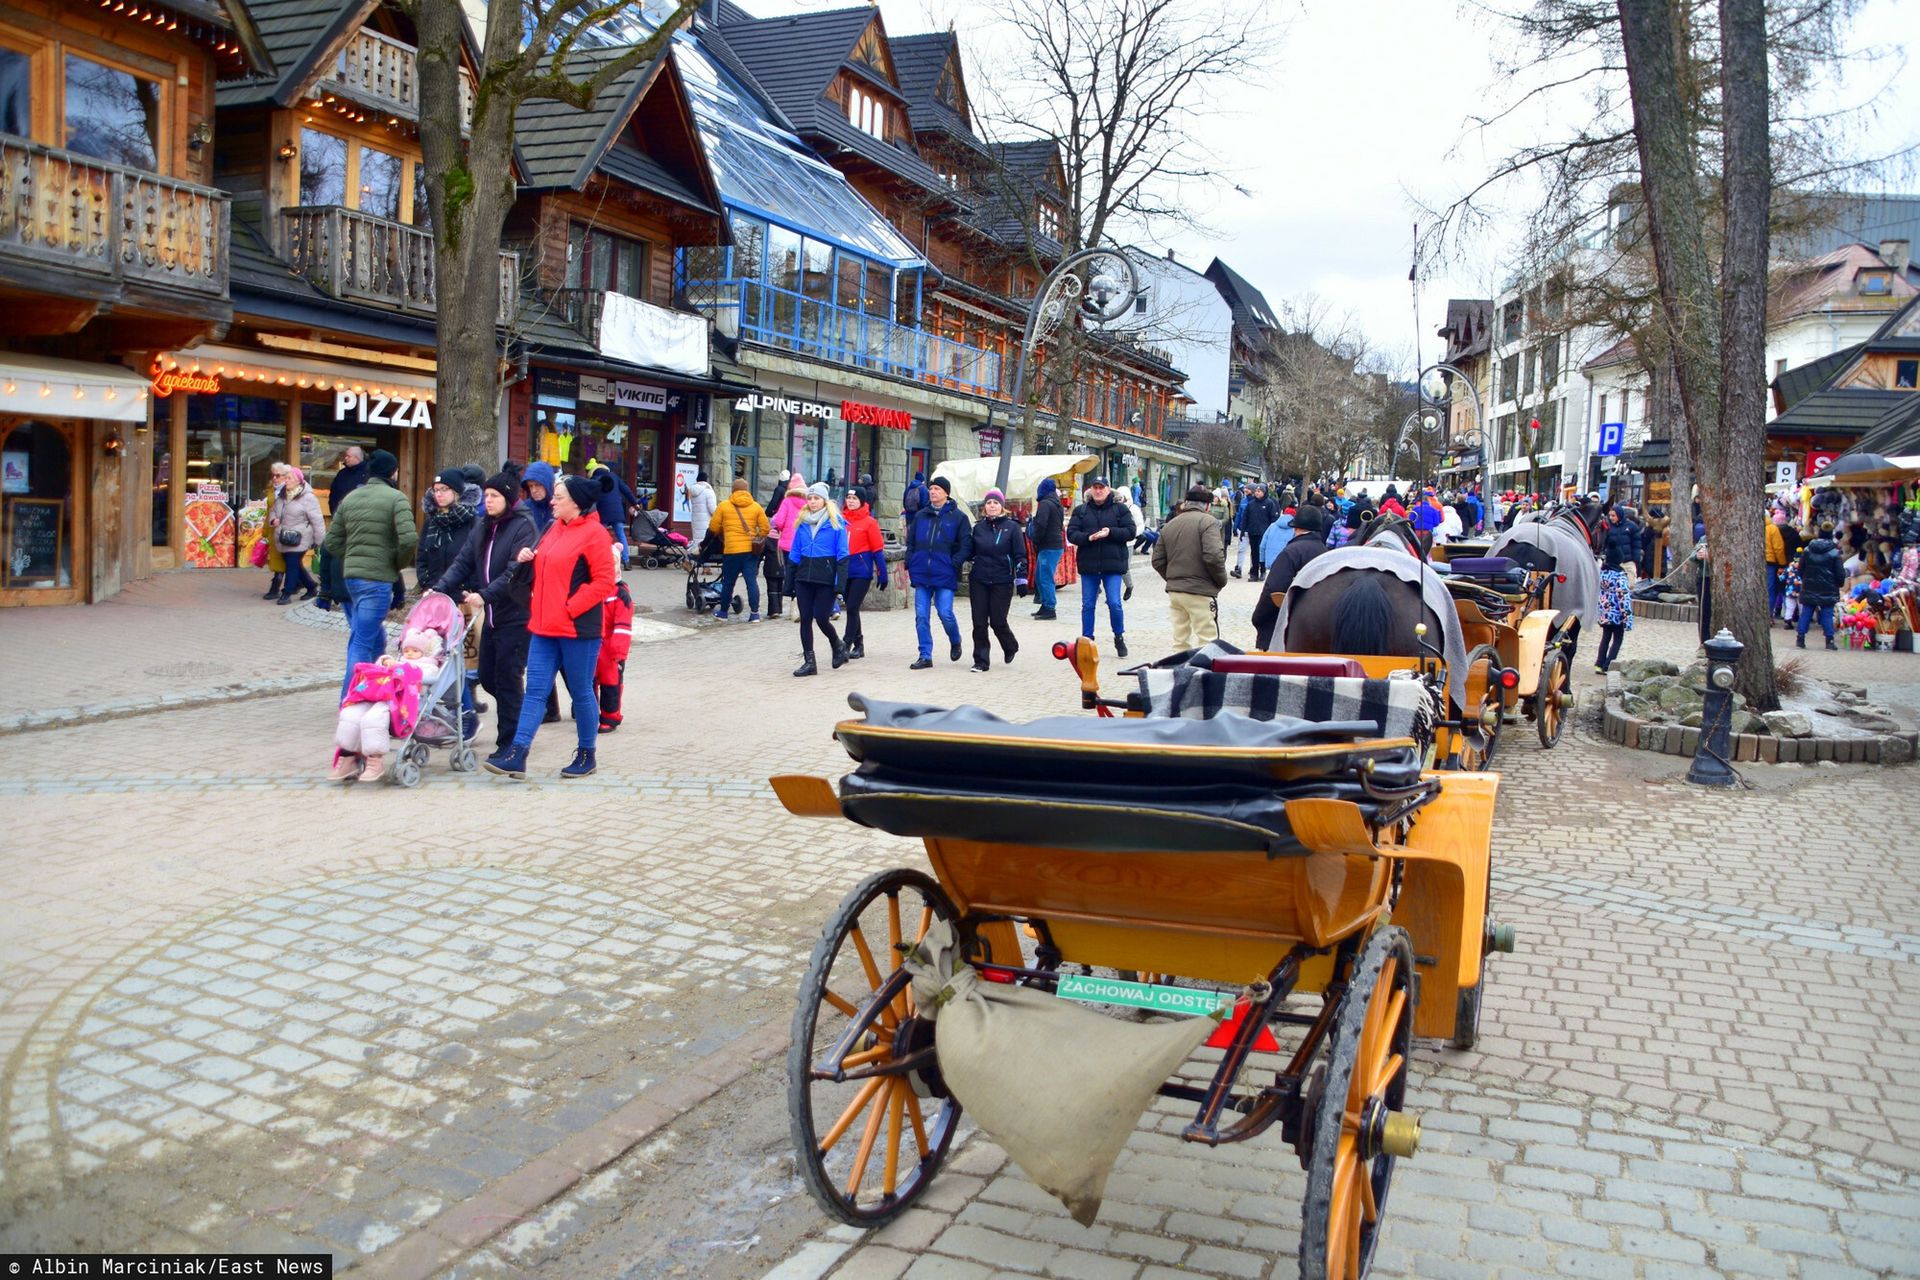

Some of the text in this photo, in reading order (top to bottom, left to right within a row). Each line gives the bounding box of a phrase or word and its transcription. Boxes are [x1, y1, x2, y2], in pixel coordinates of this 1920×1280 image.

[151, 363, 220, 396] Zapiekanki
[580, 382, 606, 393] MILO
[617, 387, 665, 405] VIKING
[667, 396, 680, 408] 4F
[335, 390, 433, 429] PIZZA
[802, 402, 833, 420] PRO
[840, 400, 911, 431] ROSSMANN
[606, 425, 628, 444] 4F
[1602, 426, 1620, 452] P
[679, 436, 697, 454] 4F
[199, 483, 220, 492] Pizza
[1062, 982, 1155, 1002] ZACHOWAJ
